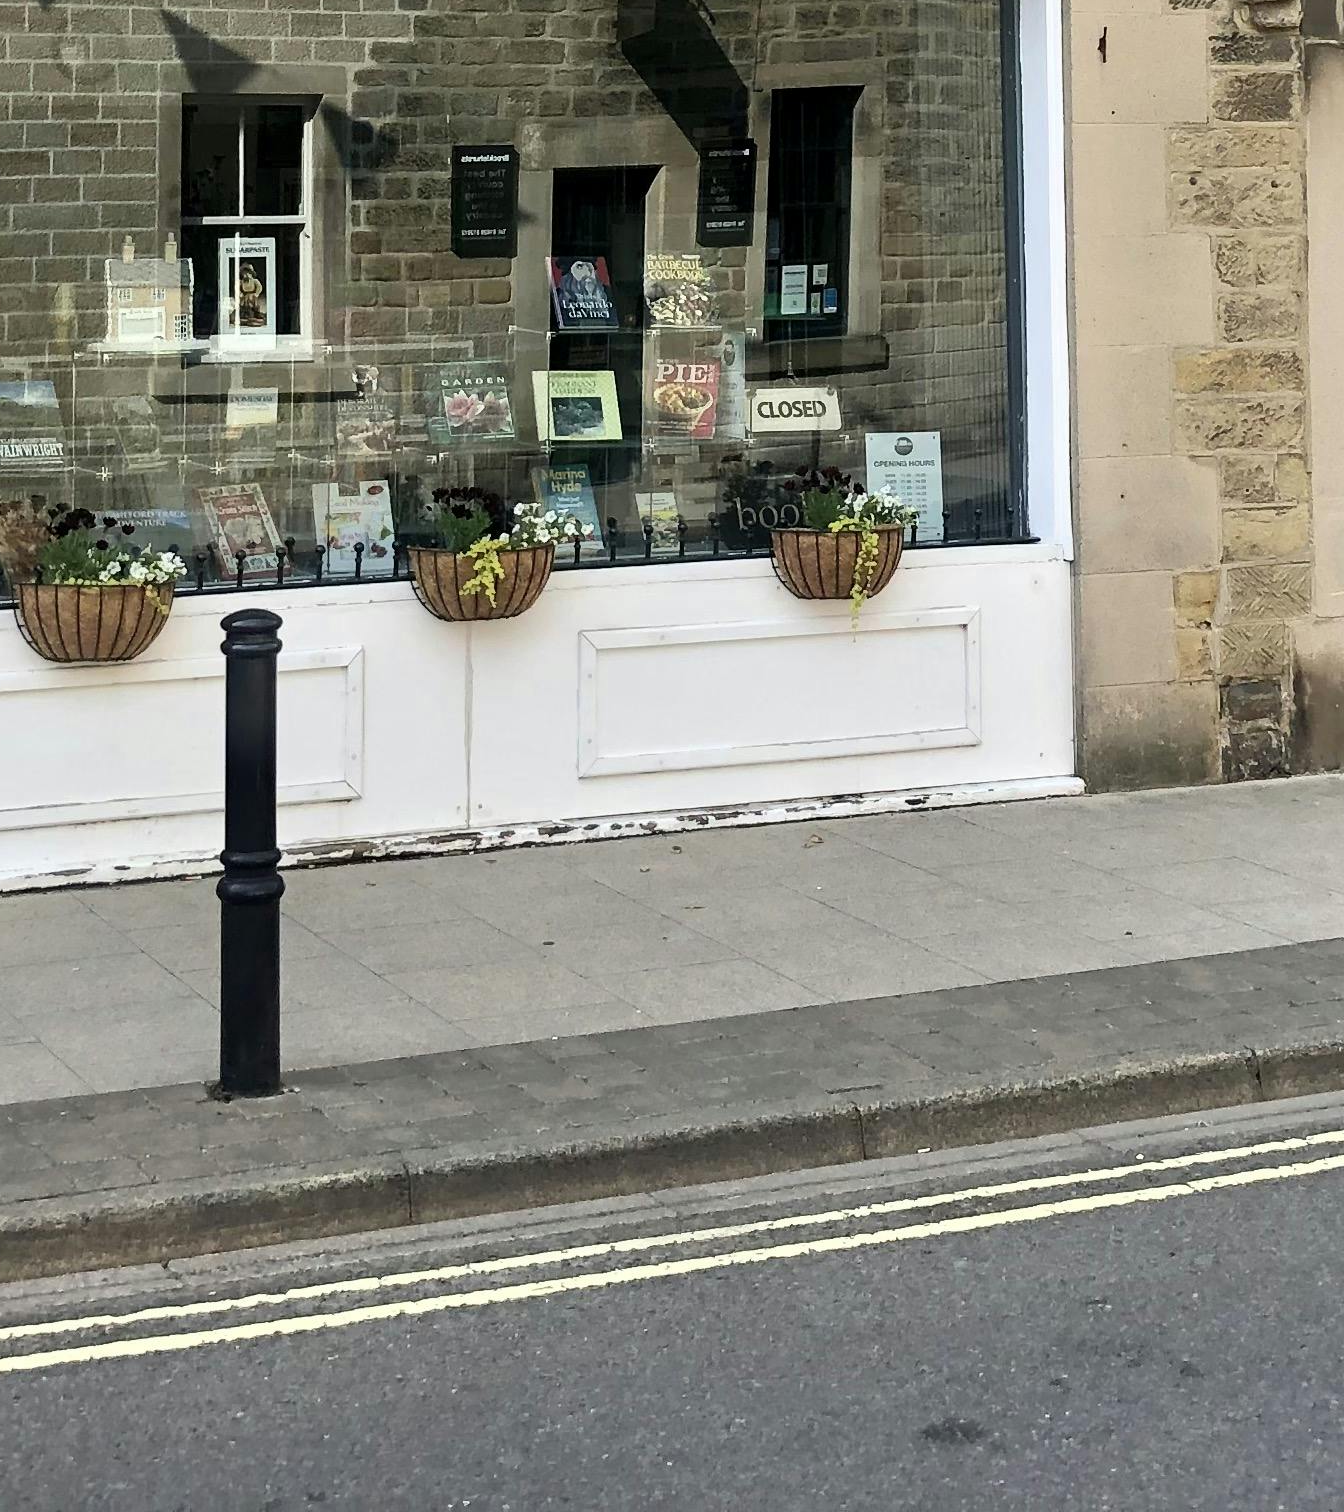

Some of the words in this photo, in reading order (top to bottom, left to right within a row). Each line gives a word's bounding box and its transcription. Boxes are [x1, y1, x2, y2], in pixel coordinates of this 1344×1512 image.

[225, 246, 270, 254] SUARPASTE
[562, 298, 613, 311] Leonardo
[654, 363, 708, 383] PIE
[757, 400, 827, 419] CLOSED
[873, 460, 908, 468] OPENING
[909, 459, 936, 467] HOURS
[115, 518, 167, 528] DVENTURE
